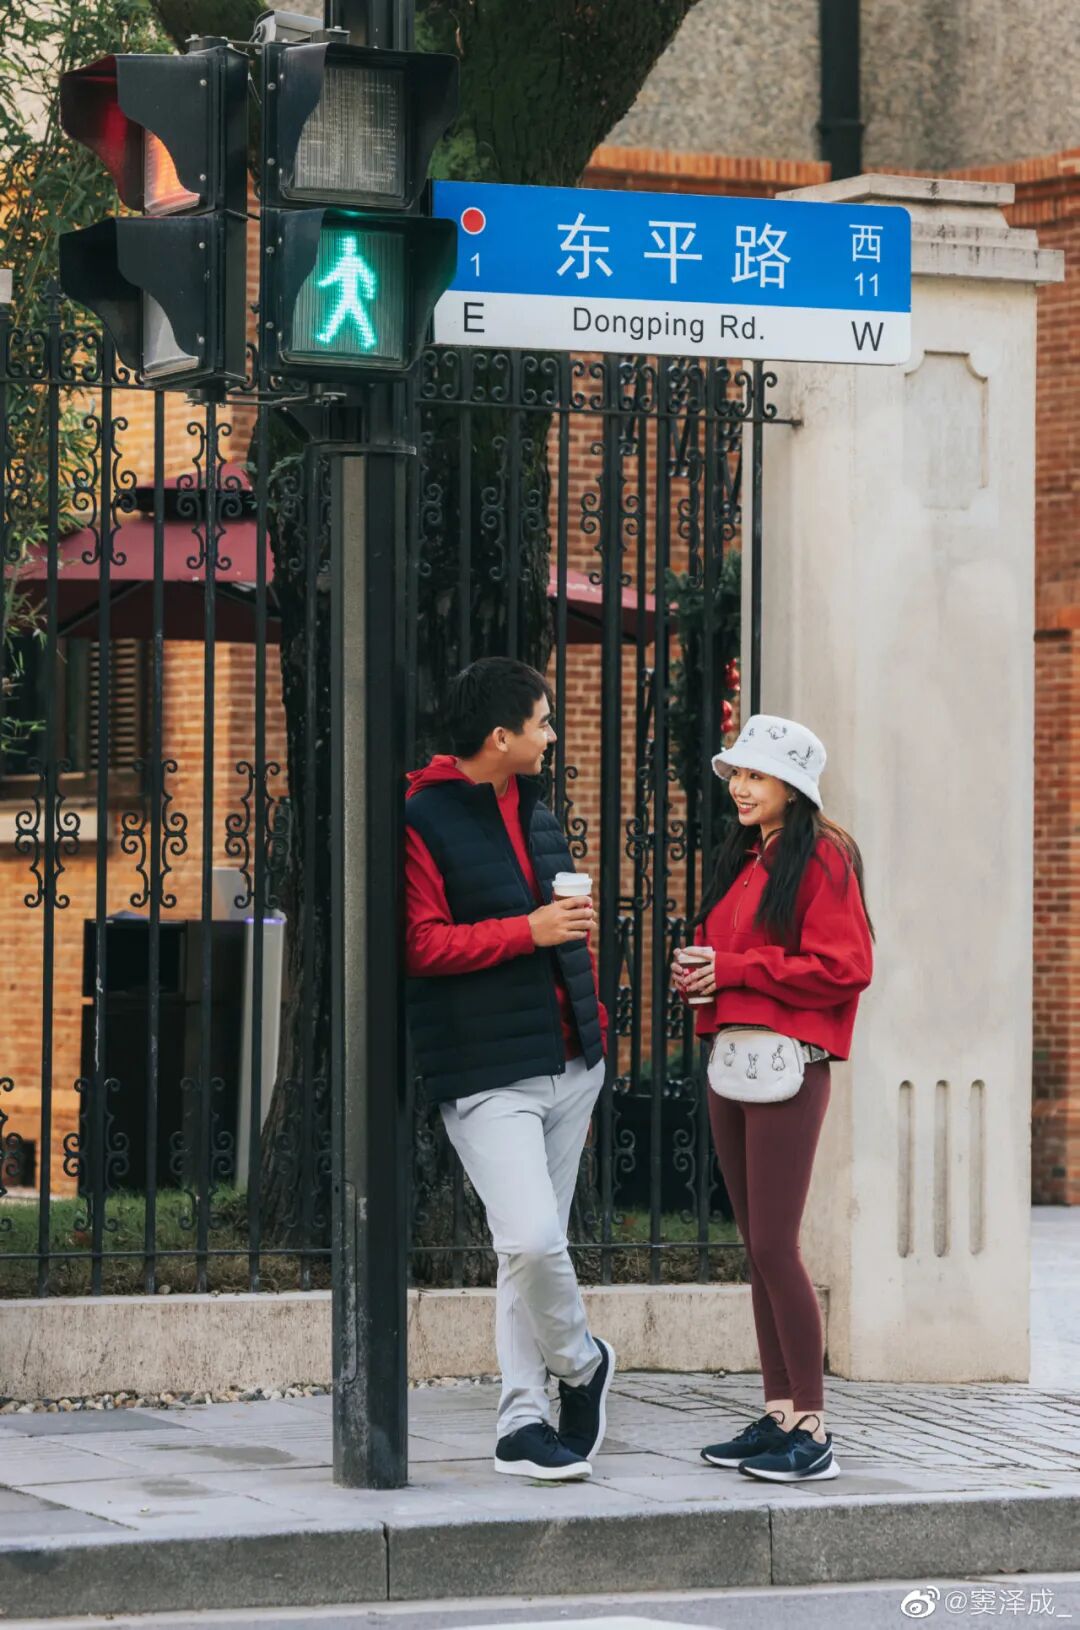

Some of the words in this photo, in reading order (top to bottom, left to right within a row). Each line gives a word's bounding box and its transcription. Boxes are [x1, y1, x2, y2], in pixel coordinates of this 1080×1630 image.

[556, 212, 792, 290] 东平路
[848, 223, 884, 264] 西
[469, 252, 481, 277] 1
[853, 272, 880, 298] 11
[463, 302, 485, 333] E
[573, 307, 704, 343] Dongping
[720, 314, 764, 341] Rd.
[851, 321, 885, 352] W
